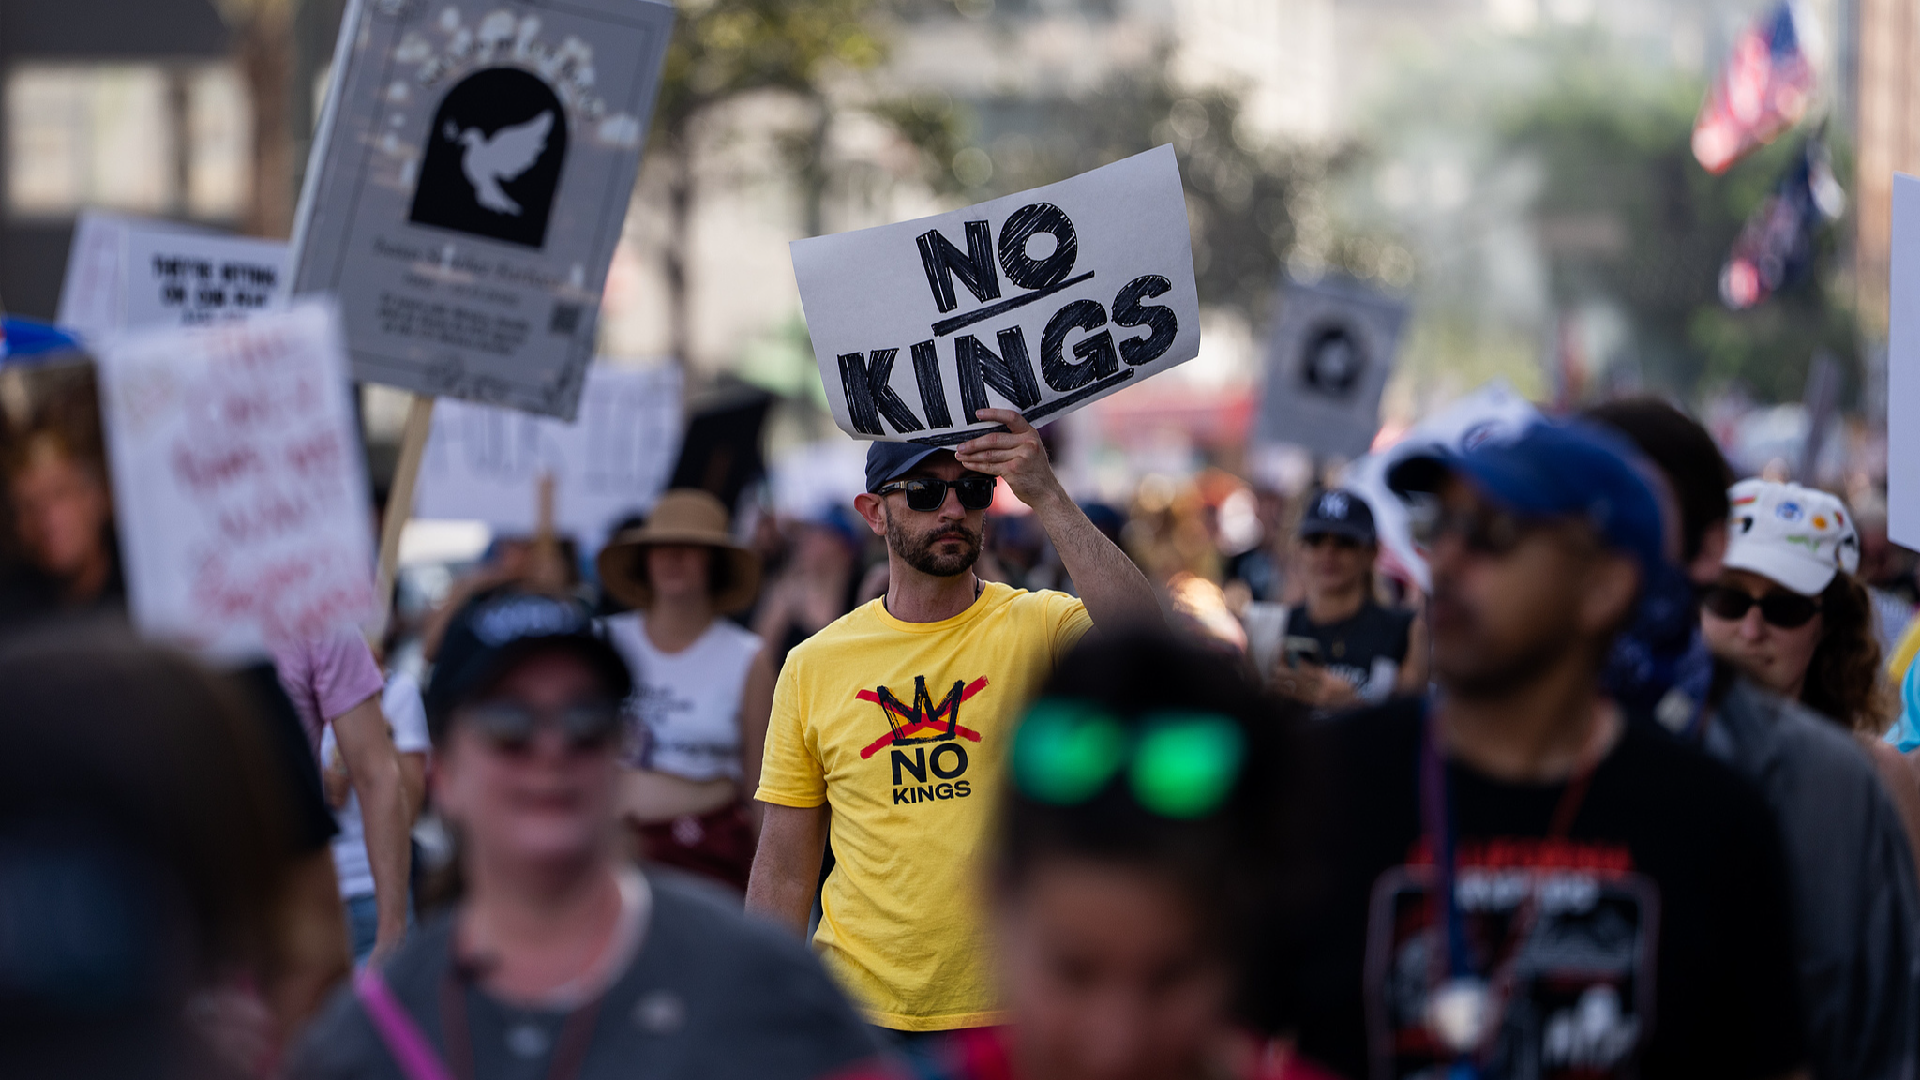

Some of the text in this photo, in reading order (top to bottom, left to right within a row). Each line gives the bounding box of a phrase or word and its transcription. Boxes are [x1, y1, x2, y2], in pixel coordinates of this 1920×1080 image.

[915, 202, 1078, 313] NO
[836, 274, 1179, 436] KINGS
[891, 742, 969, 786] NO
[892, 780, 972, 805] KINGS
